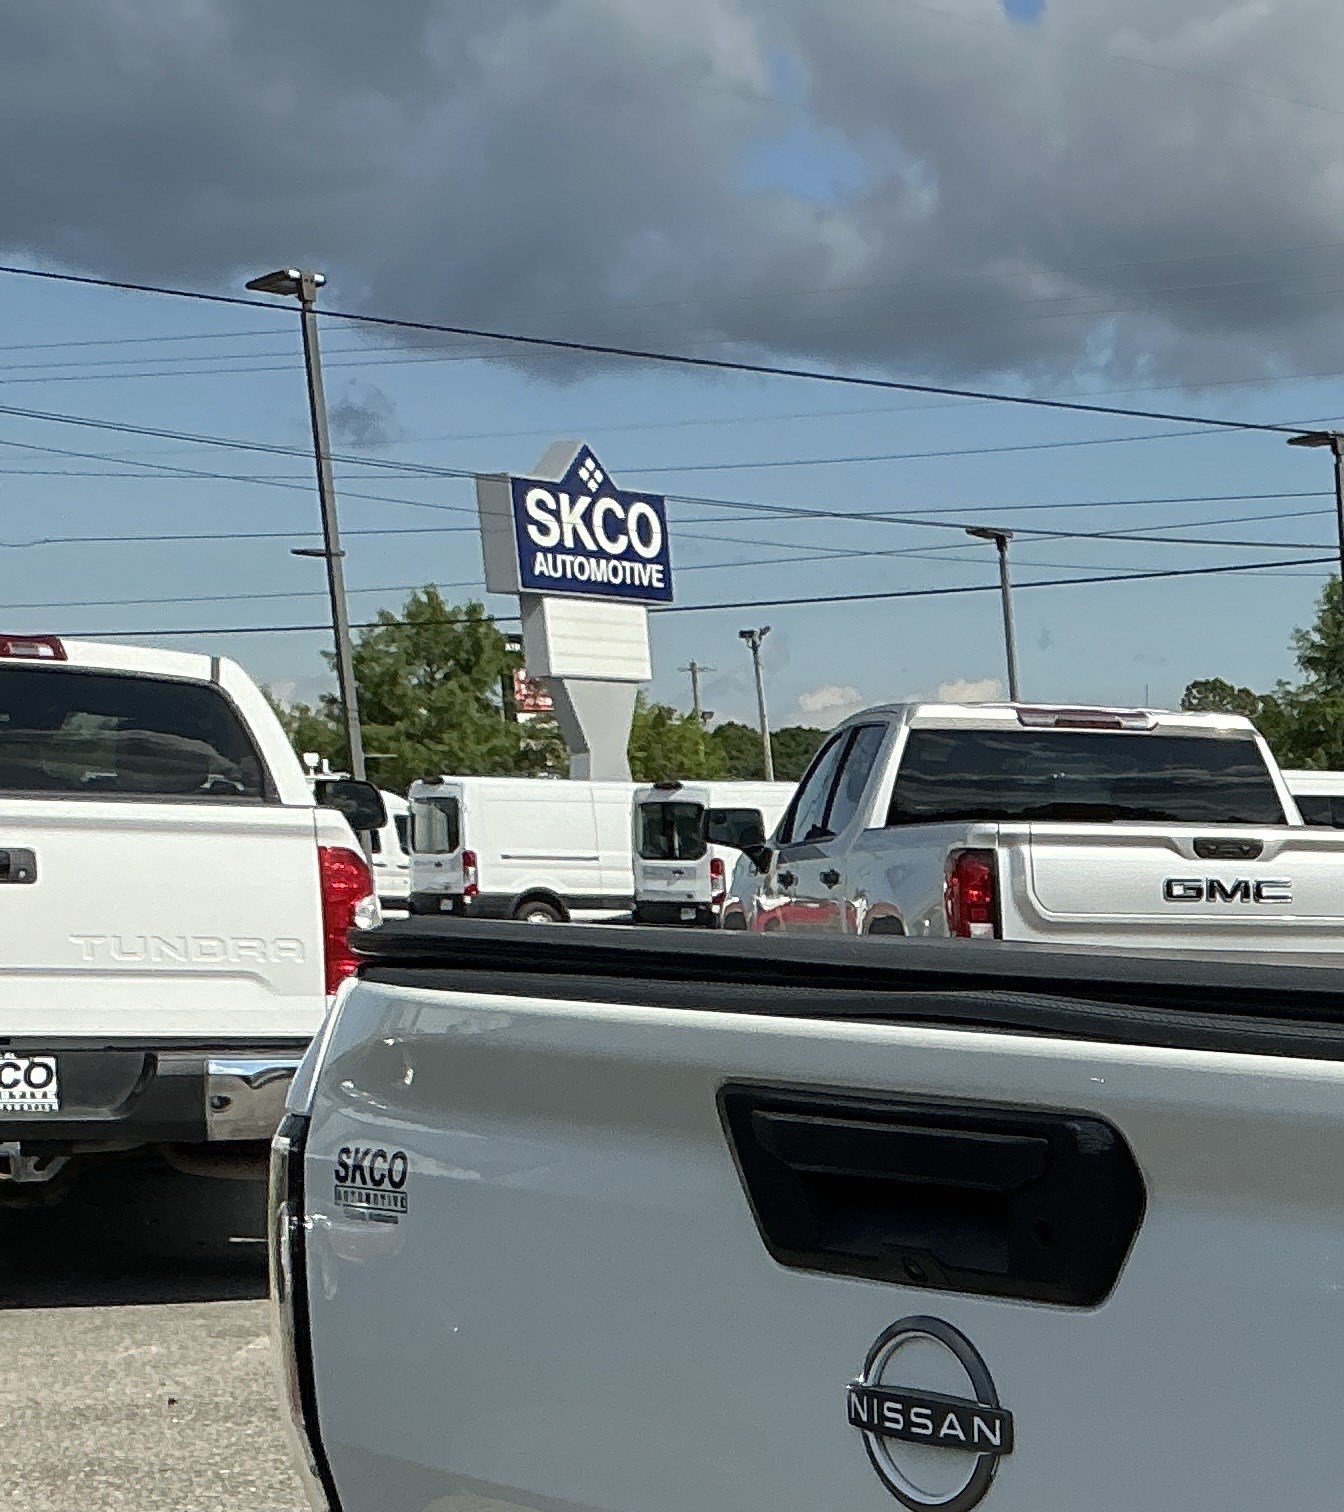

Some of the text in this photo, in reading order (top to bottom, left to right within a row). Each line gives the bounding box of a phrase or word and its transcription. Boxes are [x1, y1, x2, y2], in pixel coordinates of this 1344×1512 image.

[525, 488, 662, 559] SKCO
[534, 552, 665, 588] AUTOMOTIVE
[1163, 877, 1293, 904] GMC
[69, 934, 305, 964] TUNDRA
[334, 1147, 408, 1190] SKCO
[850, 1392, 1001, 1446] NISSAN
